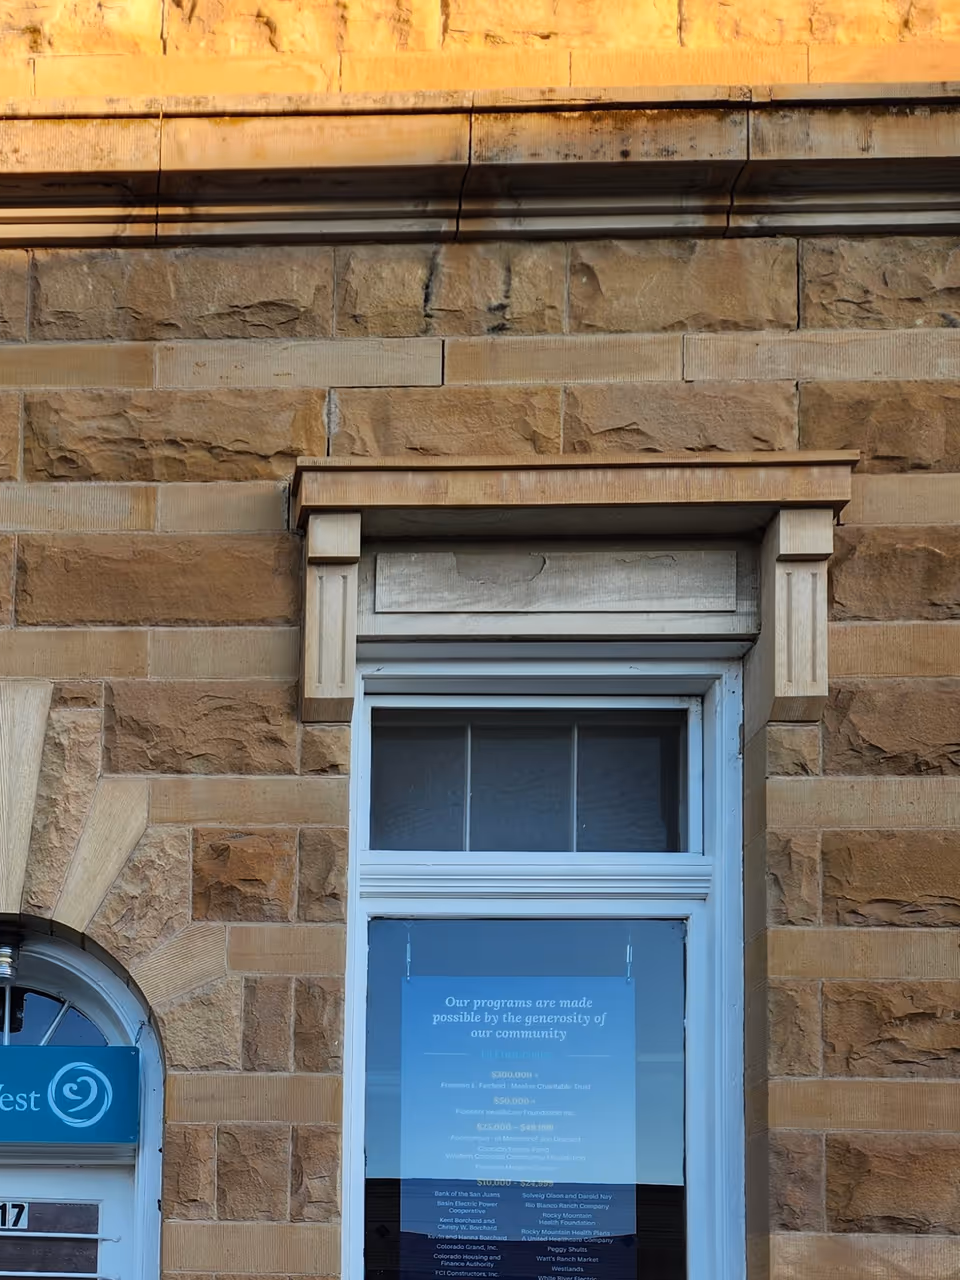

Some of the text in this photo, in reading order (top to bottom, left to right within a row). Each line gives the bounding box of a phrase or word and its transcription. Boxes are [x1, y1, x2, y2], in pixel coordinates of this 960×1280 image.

[445, 996, 593, 1011] Our programs are made
[432, 1011, 608, 1026] possible by the generosity of
[470, 1028, 567, 1041] our community
